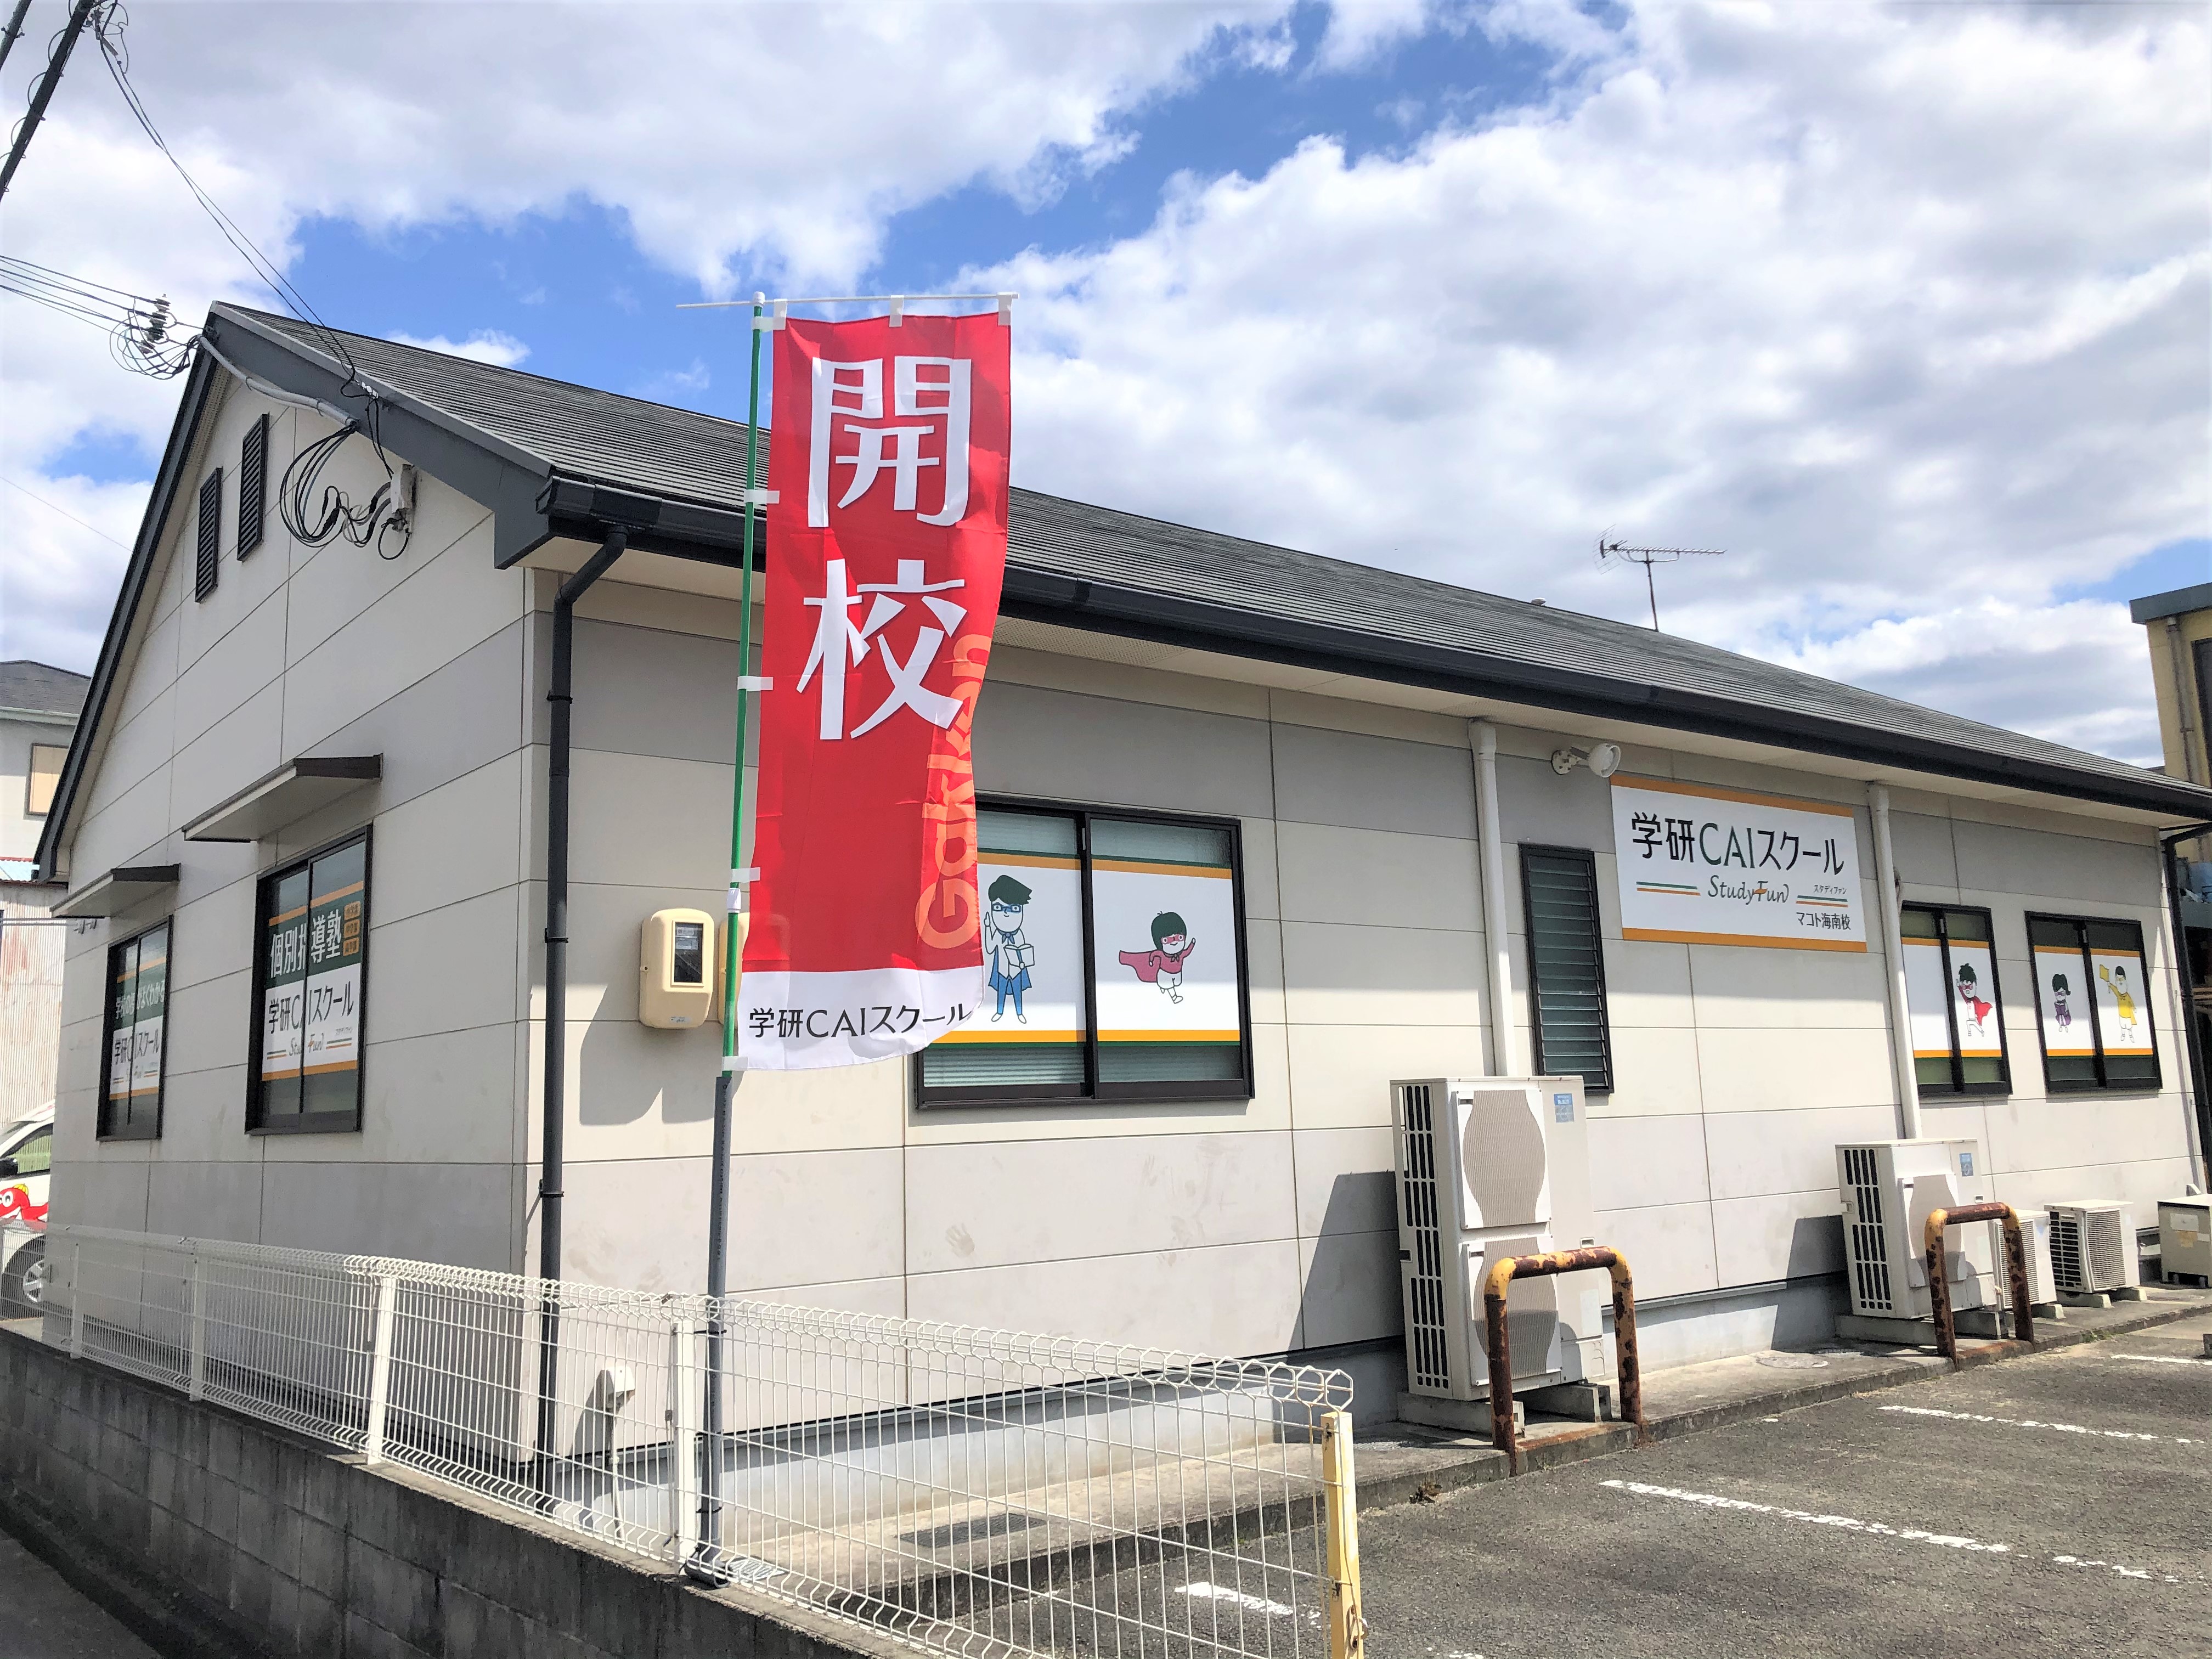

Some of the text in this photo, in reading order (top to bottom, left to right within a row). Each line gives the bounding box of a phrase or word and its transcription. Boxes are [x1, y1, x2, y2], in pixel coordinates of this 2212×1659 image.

[797, 356, 972, 740] 開校
[916, 634, 992, 949] Gakken
[1631, 812, 1844, 875] 学研CAIスクール
[1814, 884, 1847, 895] スタディファン
[1796, 912, 1852, 930] マコト海南校
[268, 981, 354, 1034] 学研CIスクール
[749, 1003, 972, 1039] 学研CAIスクール
[115, 1029, 160, 1065] 学研CIスクール
